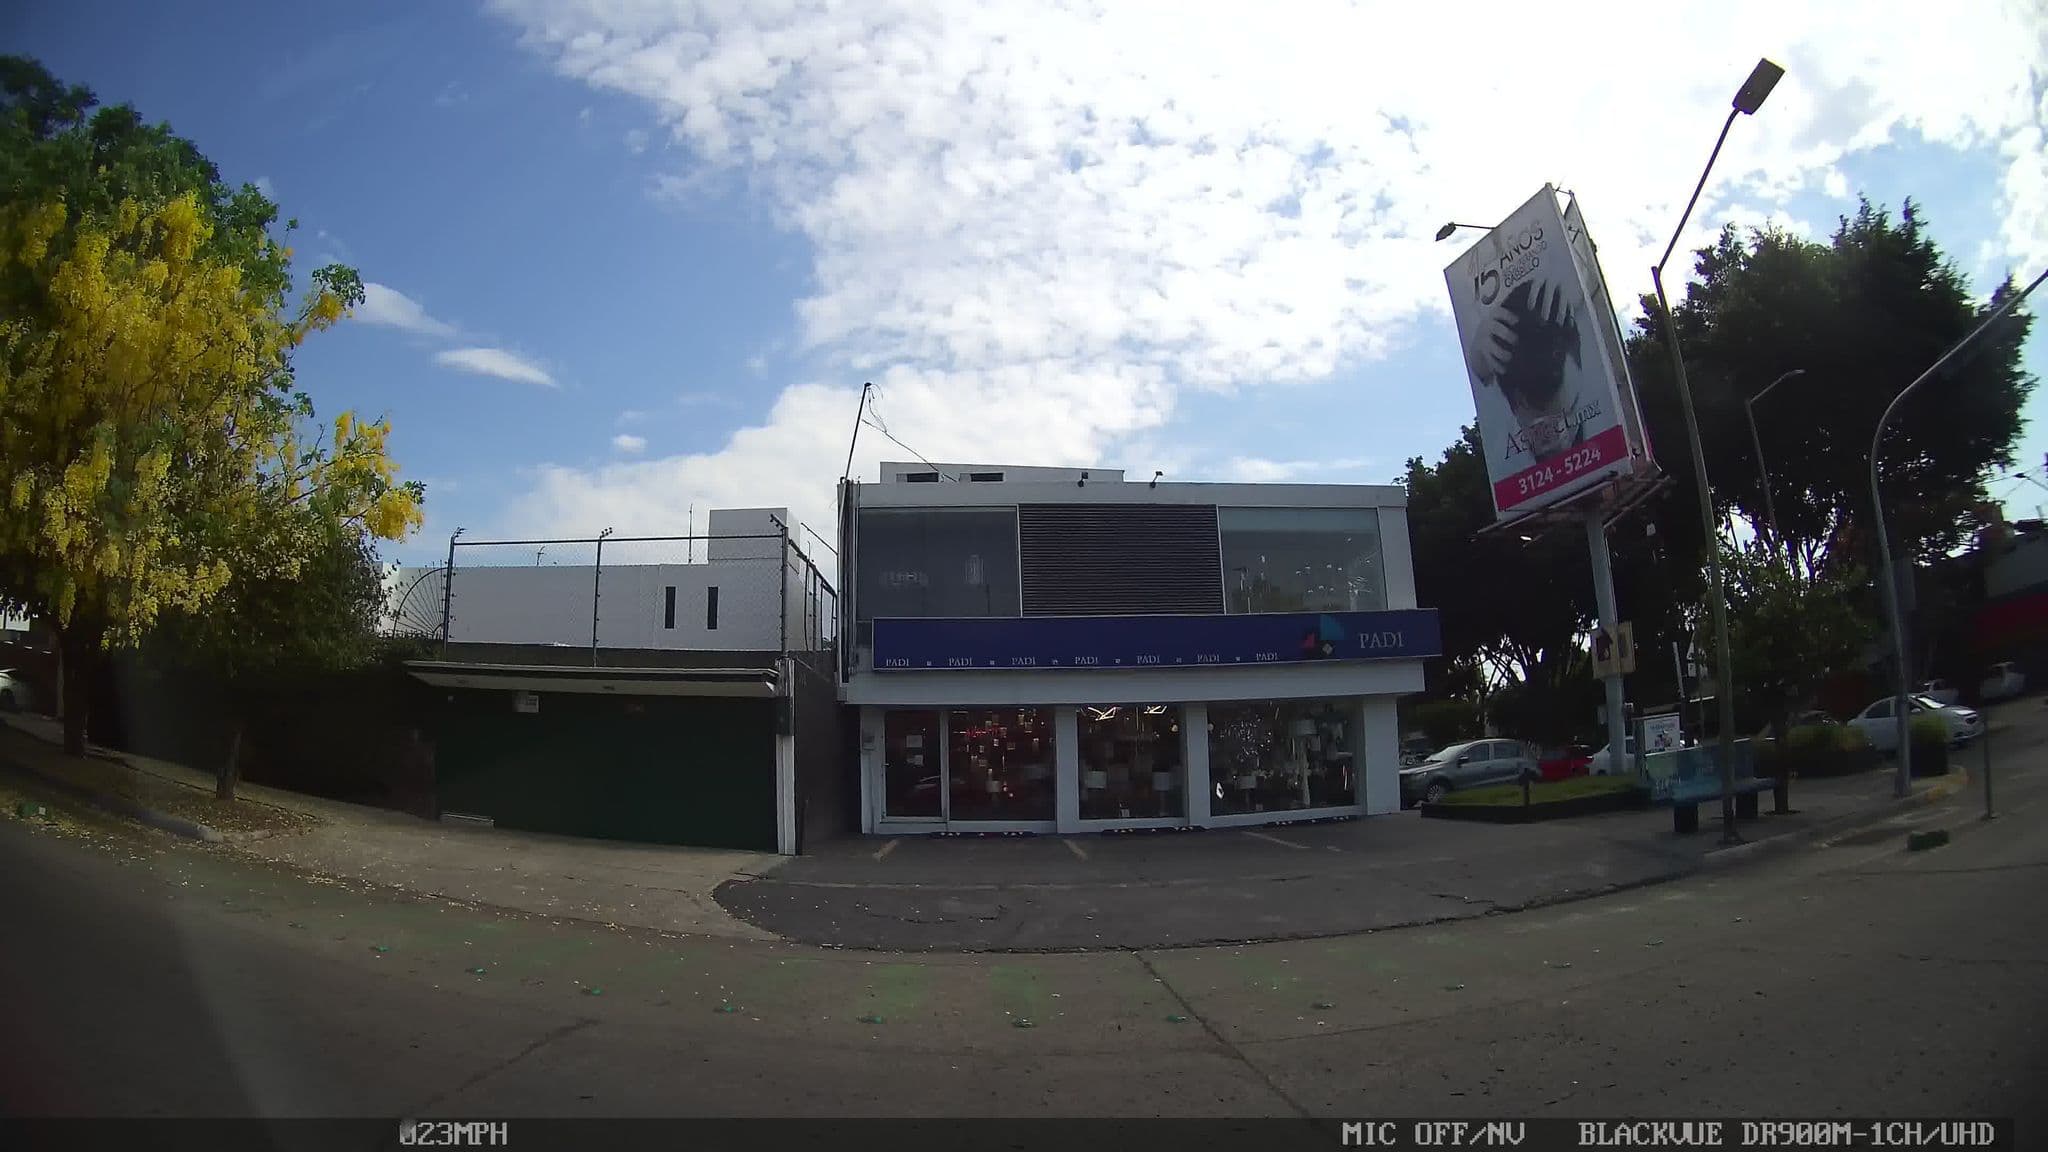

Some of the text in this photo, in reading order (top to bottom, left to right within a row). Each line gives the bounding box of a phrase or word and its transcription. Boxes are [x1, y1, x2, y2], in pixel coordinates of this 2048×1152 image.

[1473, 270, 1500, 306] 15
[1518, 466, 1554, 495] 3124
[1564, 447, 1601, 475] 5224
[1359, 631, 1405, 649] PADI
[886, 651, 1278, 667] PADI PADI PADI PADI PADI PADI PADI
